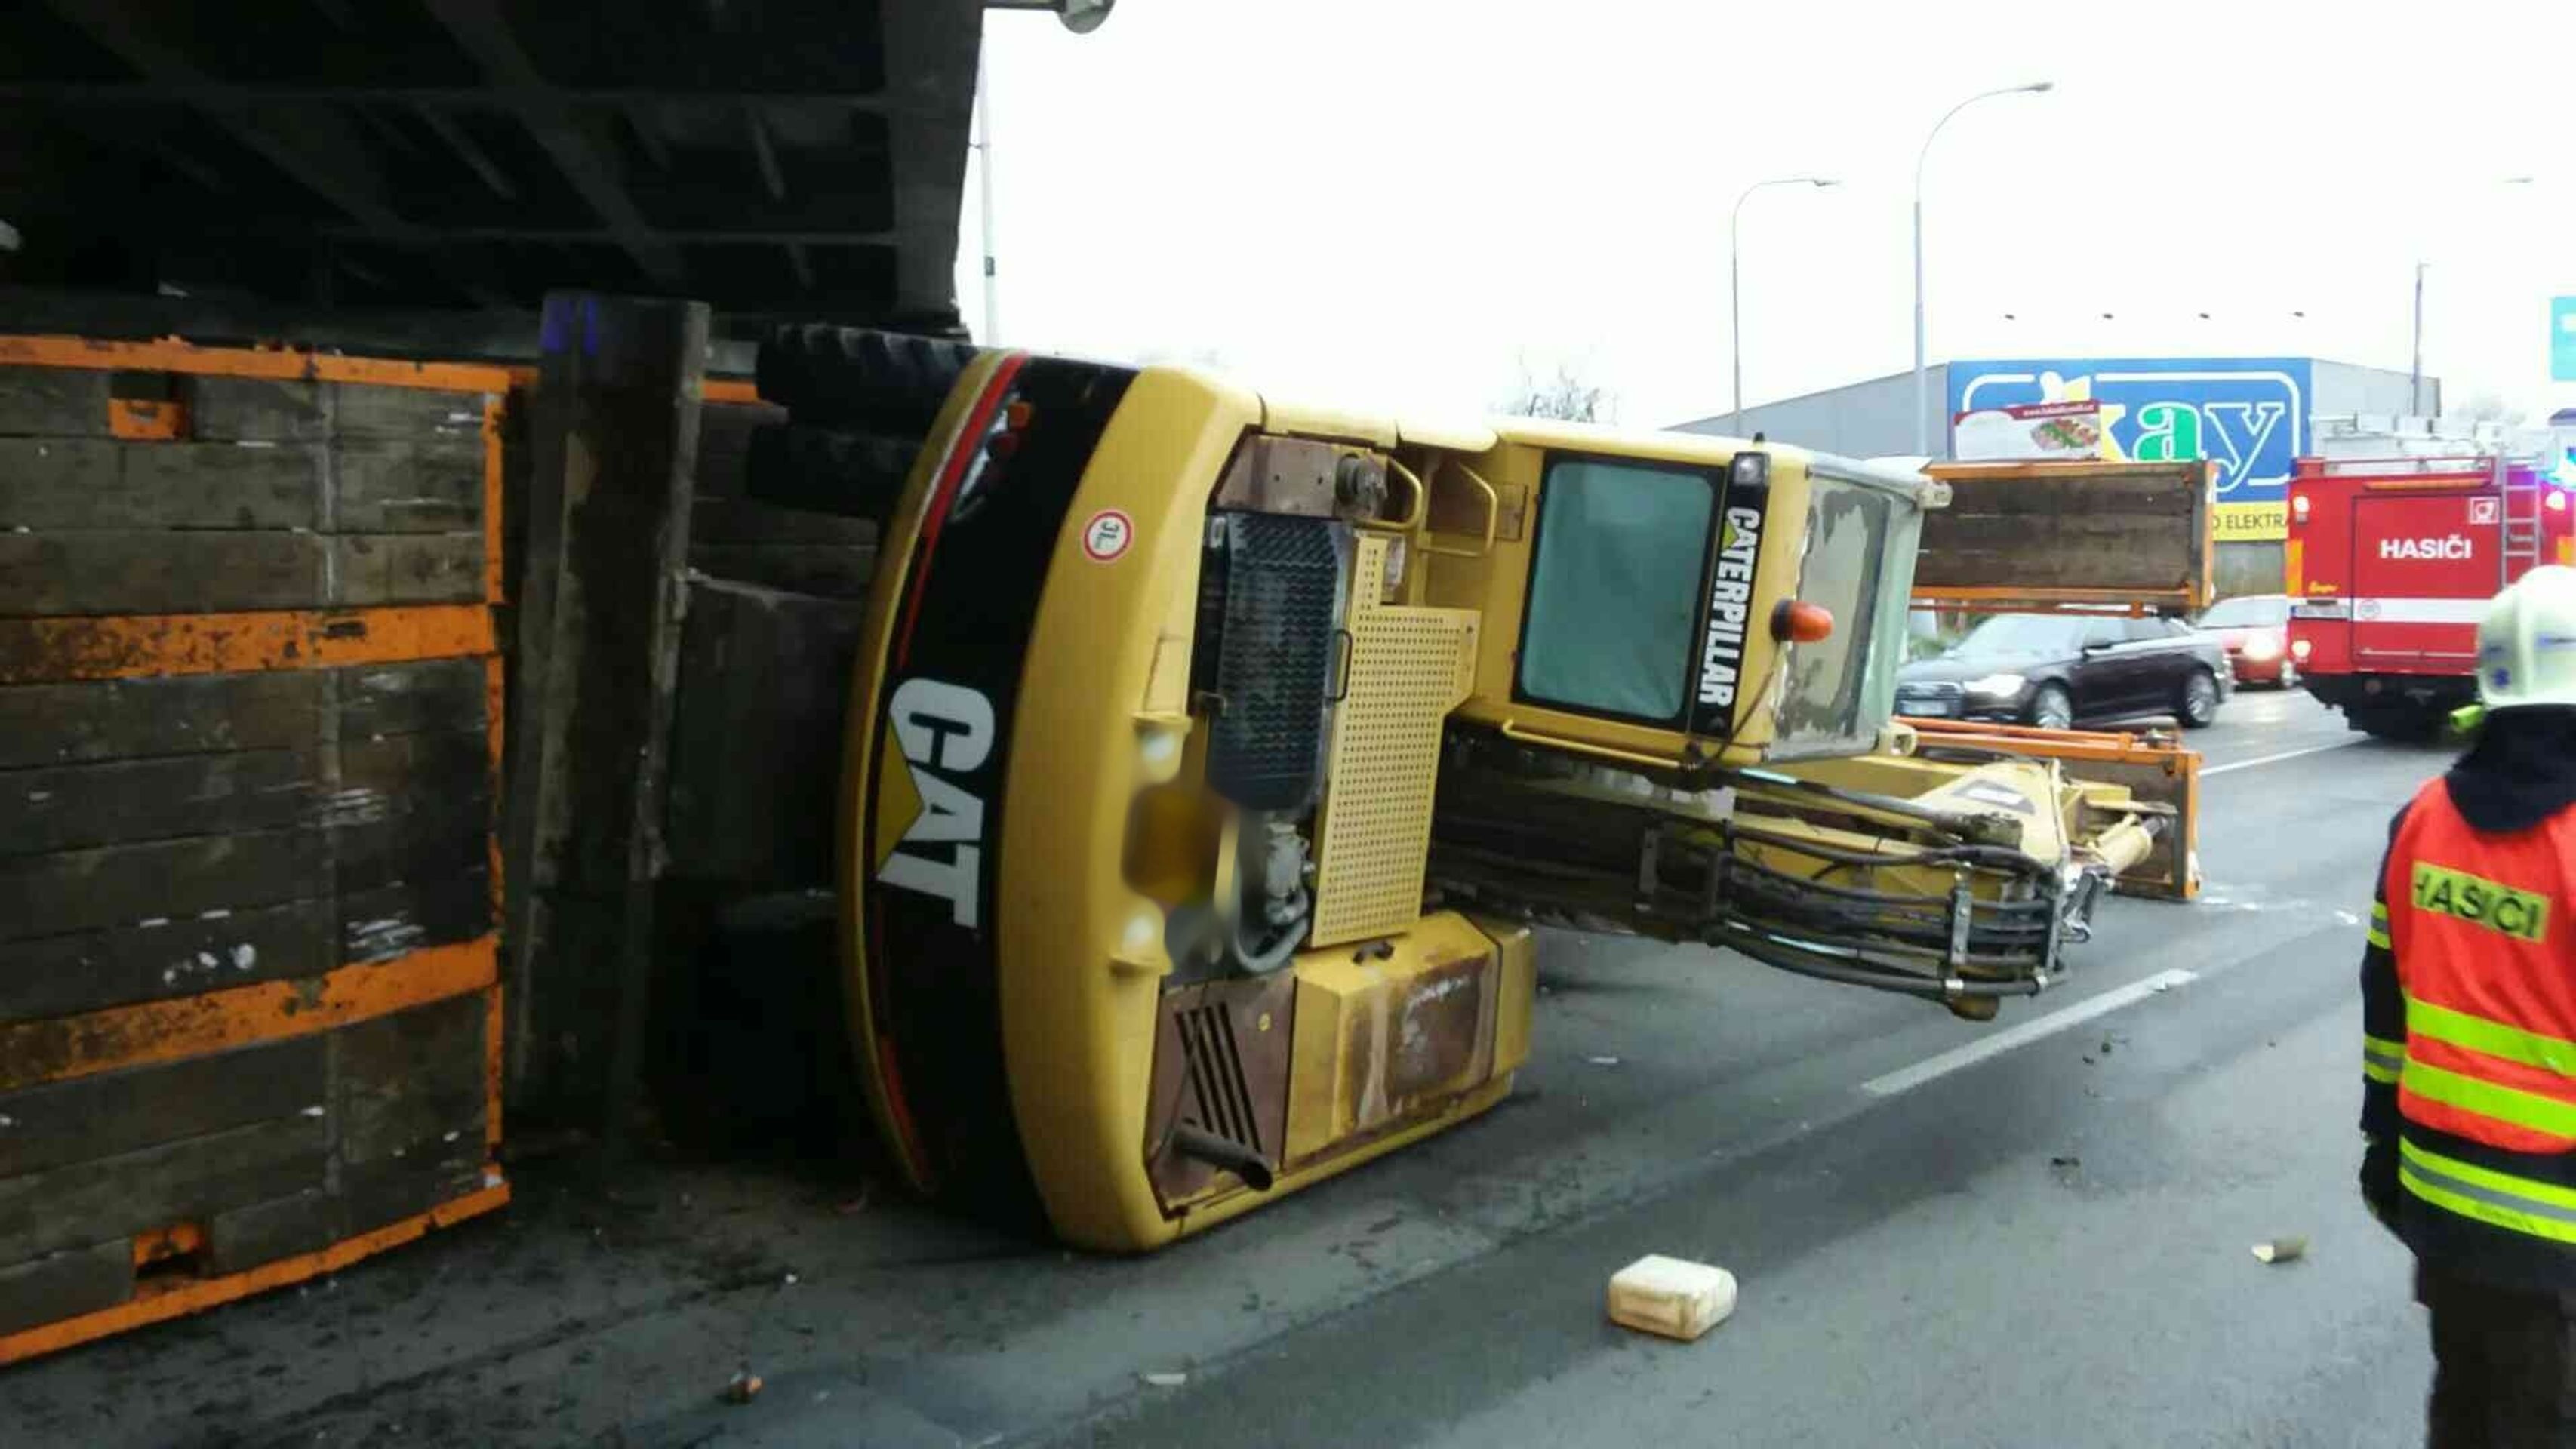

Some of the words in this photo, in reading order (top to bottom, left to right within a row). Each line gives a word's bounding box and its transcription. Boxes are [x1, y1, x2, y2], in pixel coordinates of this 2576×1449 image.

[1698, 506, 1760, 706] CATERPILLAR
[2380, 534, 2473, 559] HASIČI
[876, 677, 996, 929] CAT
